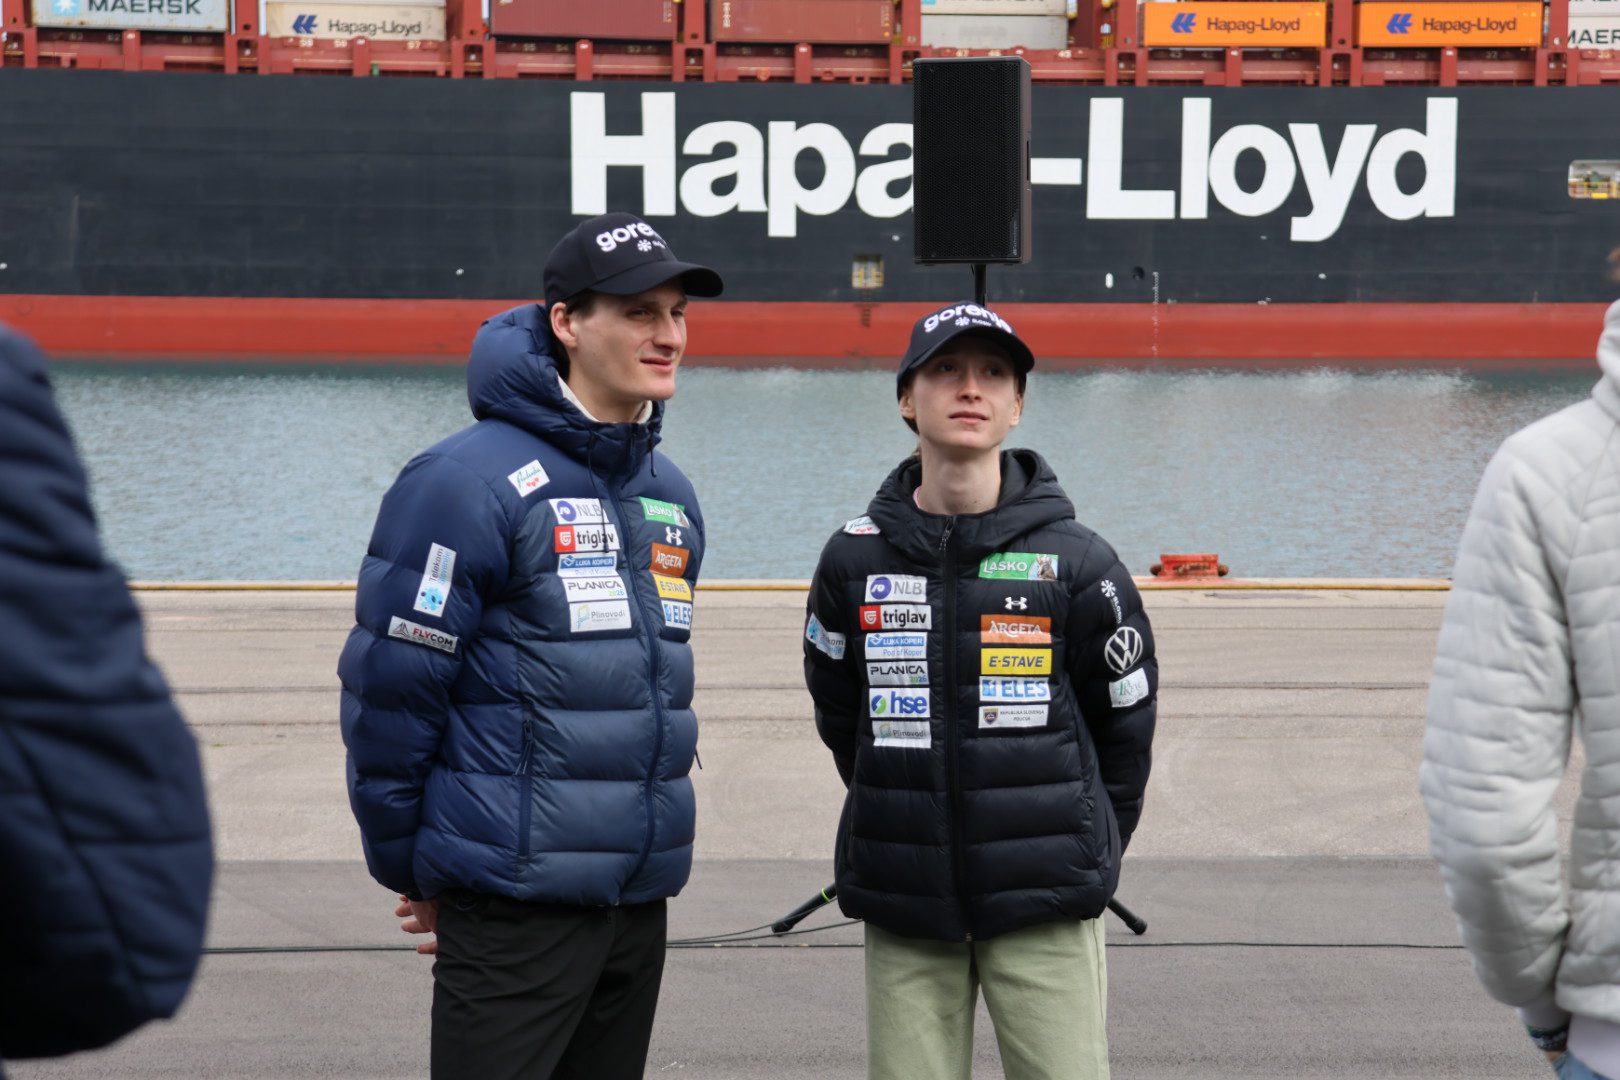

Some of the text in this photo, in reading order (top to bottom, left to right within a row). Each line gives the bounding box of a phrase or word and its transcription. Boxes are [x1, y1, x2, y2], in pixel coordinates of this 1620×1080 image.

[88, 0, 202, 14] MAERSK
[328, 19, 421, 36] Hapag-Lloyd
[1207, 17, 1300, 34] Hapag-Lloyd
[1422, 17, 1517, 33] Hapag-Lloyd
[570, 91, 1458, 242] Hapa-Lloyd
[576, 504, 602, 517] NLB
[577, 529, 614, 549] triglav
[574, 557, 613, 567] LUKA KOPER
[655, 550, 683, 569] ARGETA
[567, 580, 623, 591] PLANICA
[893, 582, 923, 595] NLB
[673, 605, 691, 624] ELES
[882, 609, 927, 628] triglav
[412, 627, 454, 647] FLYCOM
[989, 620, 1043, 638] ARGETA
[988, 655, 1045, 668] E-STAVE
[870, 665, 925, 676] PLANICA
[1001, 679, 1047, 698] ELES
[890, 690, 927, 714] hse
